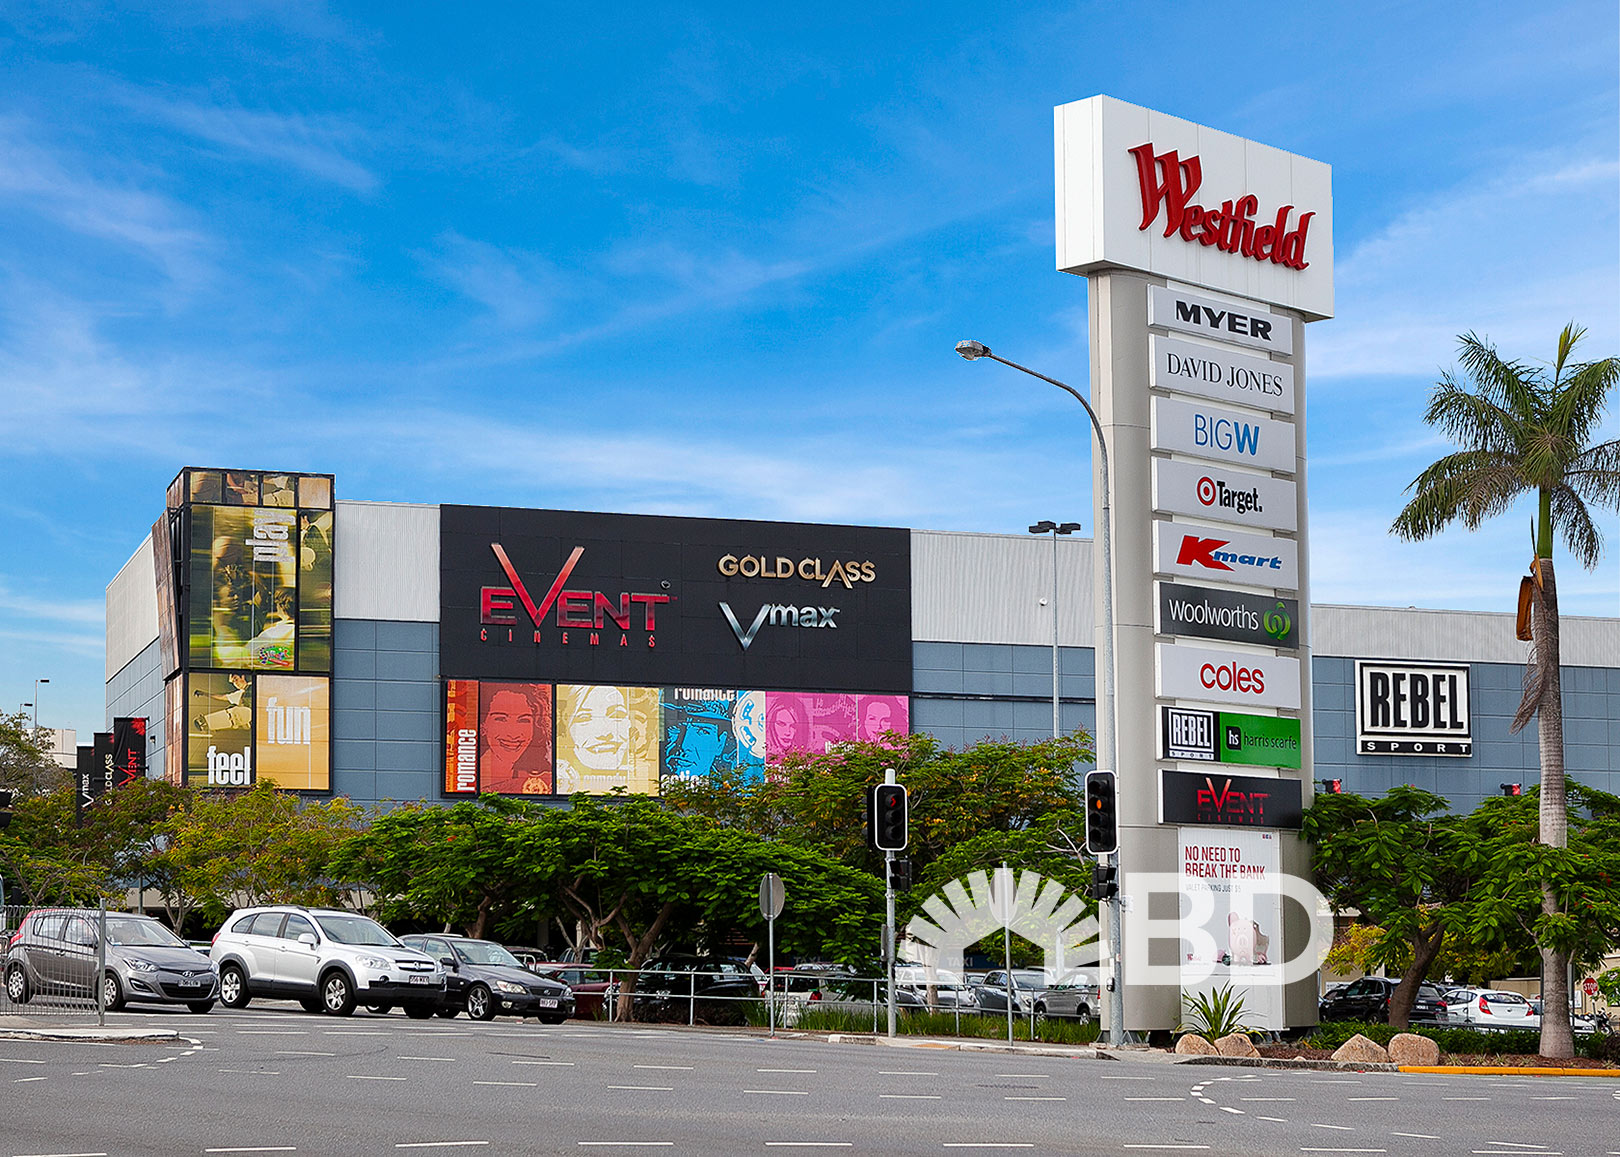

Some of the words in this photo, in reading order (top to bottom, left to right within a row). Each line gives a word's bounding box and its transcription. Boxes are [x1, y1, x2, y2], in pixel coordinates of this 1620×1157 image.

[1128, 142, 1316, 271] Westfield
[1175, 300, 1272, 341] MYER
[1167, 353, 1221, 383] DAVID
[1227, 366, 1283, 397] JONES
[717, 553, 795, 579] GOLD
[798, 557, 876, 589] CLASS
[1176, 535, 1282, 572] Kmart
[480, 542, 671, 631] EVENT
[480, 627, 656, 647] CINEMAS
[718, 601, 840, 651] Vmax
[1200, 661, 1265, 694] coles
[1369, 671, 1464, 729] REBEL
[266, 696, 311, 745] fun
[1172, 714, 1210, 747] REBEL
[1228, 730, 1239, 745] hs
[1171, 751, 1213, 760] SPORT
[1244, 732, 1269, 747] harris
[1270, 734, 1297, 749] scarfe
[1367, 742, 1468, 753] SPORT
[207, 745, 251, 785] feel
[457, 729, 477, 791] romance
[1197, 777, 1269, 815] EVENT
[1185, 846, 1199, 861] NO
[1201, 846, 1227, 863] NEED
[1228, 847, 1241, 863] TO
[1185, 862, 1218, 878] BREAK
[1219, 863, 1238, 879] THE
[1240, 864, 1266, 880] BANK
[946, 957, 973, 967] TAXI
